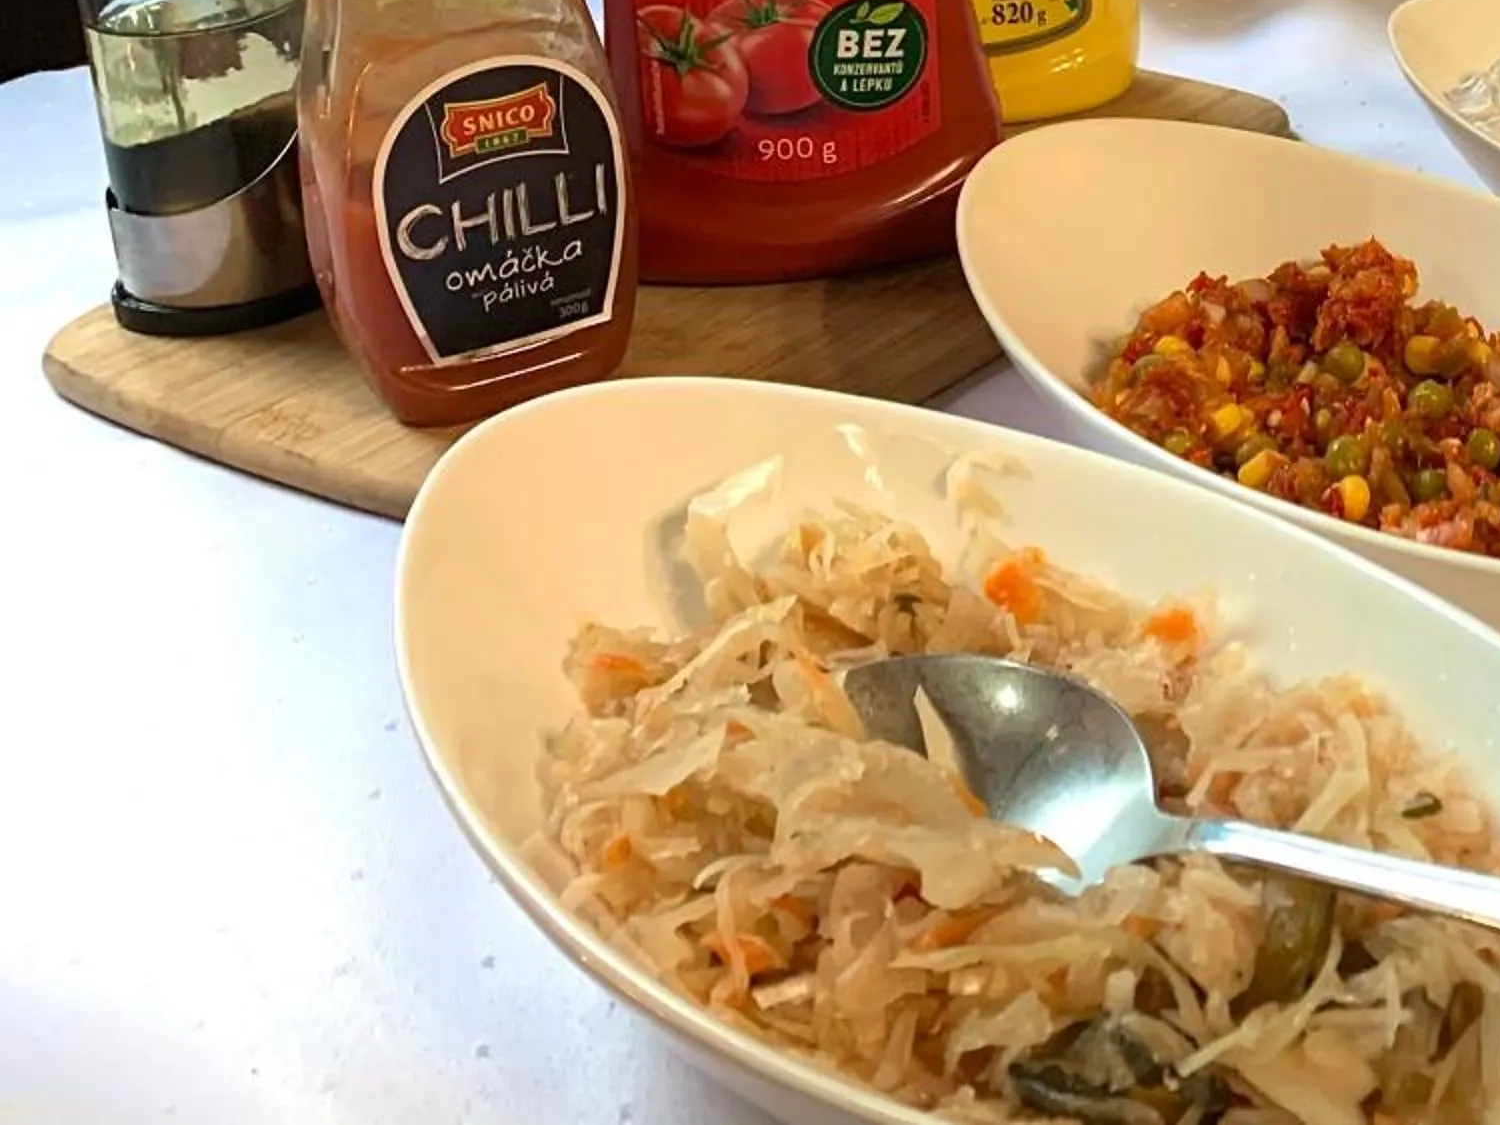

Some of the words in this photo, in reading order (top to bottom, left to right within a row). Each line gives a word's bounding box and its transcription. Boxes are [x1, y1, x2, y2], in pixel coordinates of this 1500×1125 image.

[992, 2, 1034, 26] 820
[837, 28, 907, 58] BEZ
[840, 78, 848, 92] A
[463, 105, 535, 136] SNICO
[758, 137, 814, 162] 900
[822, 140, 838, 164] g
[396, 163, 608, 261] CHILLI
[445, 239, 583, 291] omáčka
[482, 270, 556, 313] pálivá
